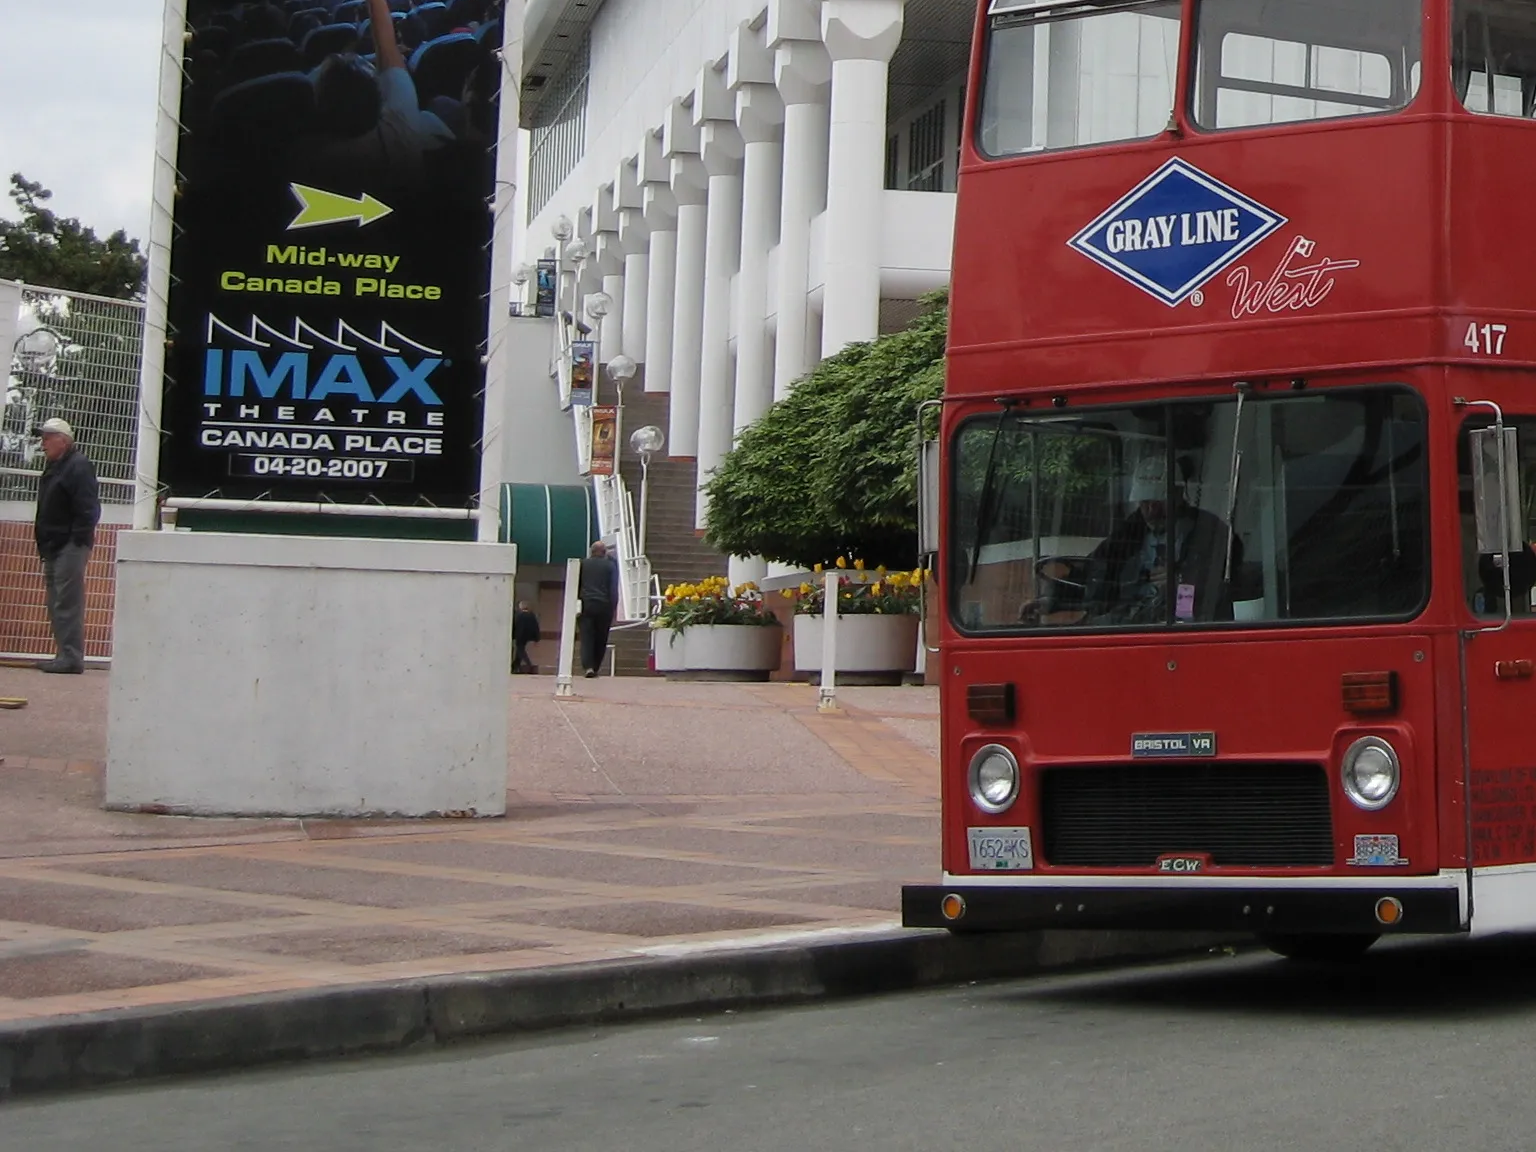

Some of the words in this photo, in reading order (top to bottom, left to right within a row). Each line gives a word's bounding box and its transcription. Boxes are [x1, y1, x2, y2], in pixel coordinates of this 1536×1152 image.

[1105, 213, 1178, 254] GRAY
[1180, 208, 1240, 246] LINE
[266, 244, 401, 273] Mid-way
[220, 271, 342, 297] Canada
[355, 277, 443, 301] Place
[1225, 235, 1361, 319] West
[1464, 322, 1508, 355] 417
[204, 349, 445, 406] IMAX
[204, 403, 444, 426] THEATRE
[201, 429, 335, 450] CANADA
[344, 434, 443, 455] PLACE
[254, 457, 389, 479] 04-20-2007
[1134, 739, 1187, 751] BRISTOL
[1160, 858, 1199, 871] ECW
